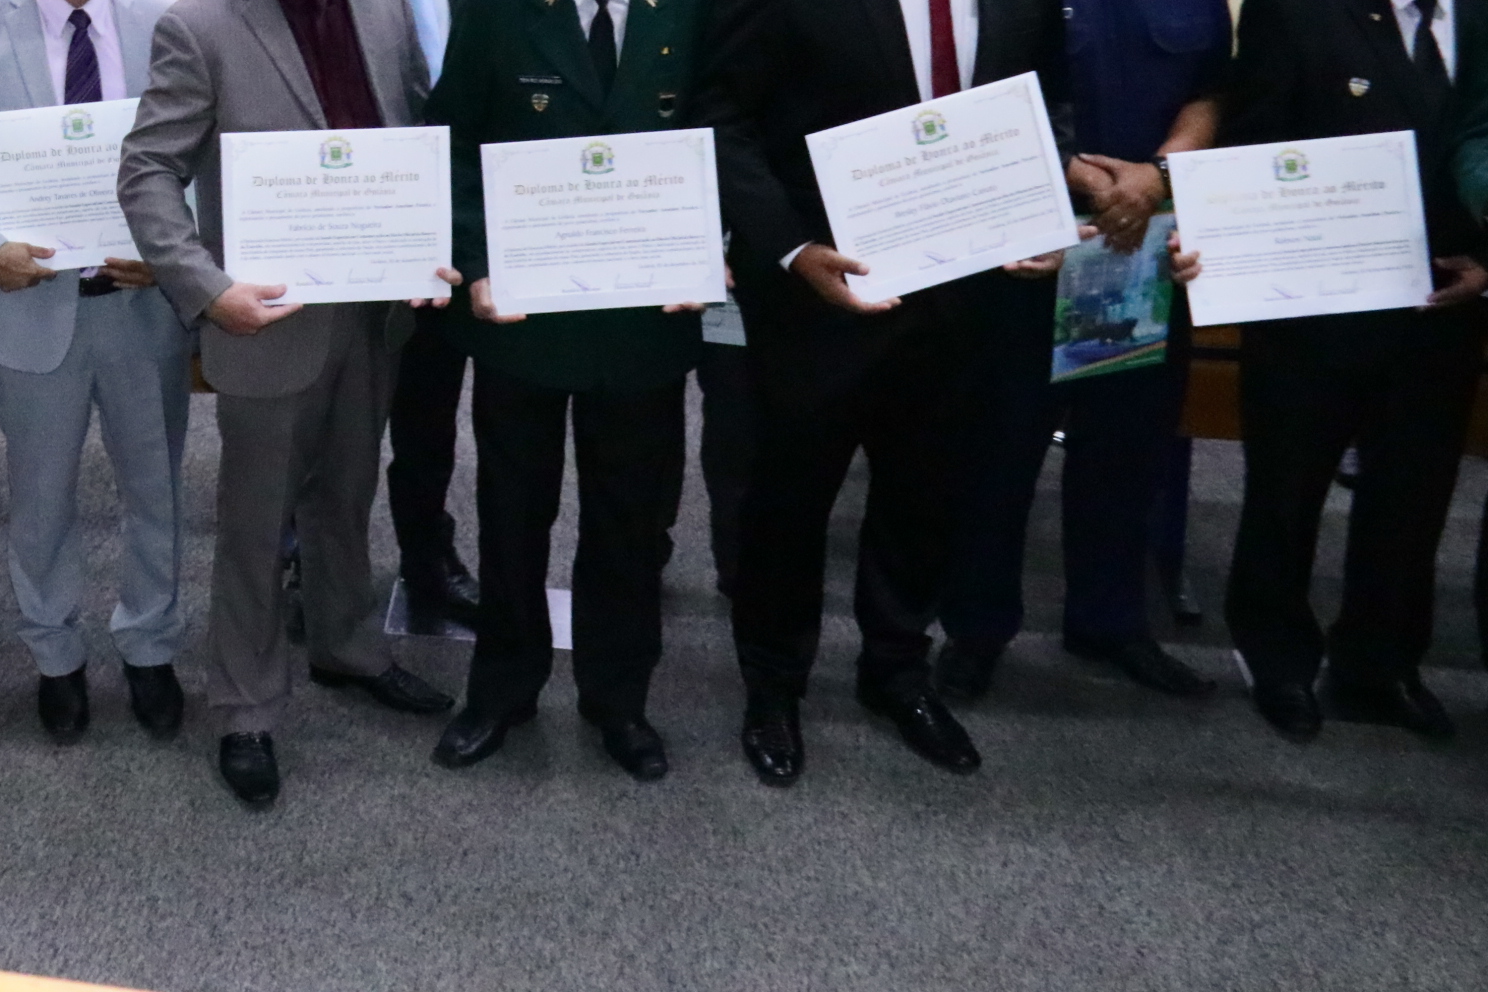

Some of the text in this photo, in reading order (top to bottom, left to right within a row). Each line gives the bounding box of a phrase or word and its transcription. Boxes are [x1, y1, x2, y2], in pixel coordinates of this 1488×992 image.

[0, 143, 118, 162] Diploma de Honra ao
[851, 160, 901, 181] Diploma
[904, 156, 916, 166] de
[921, 144, 959, 161] Honra
[963, 140, 976, 151] ao
[252, 170, 420, 187] Diploma de Honra ao Mérito
[513, 173, 684, 196] Diploma de Honra ao Mérito
[89, 189, 114, 197] Oliveira
[276, 188, 308, 199] Câmara
[310, 188, 351, 198] Municipal
[352, 188, 361, 196] de
